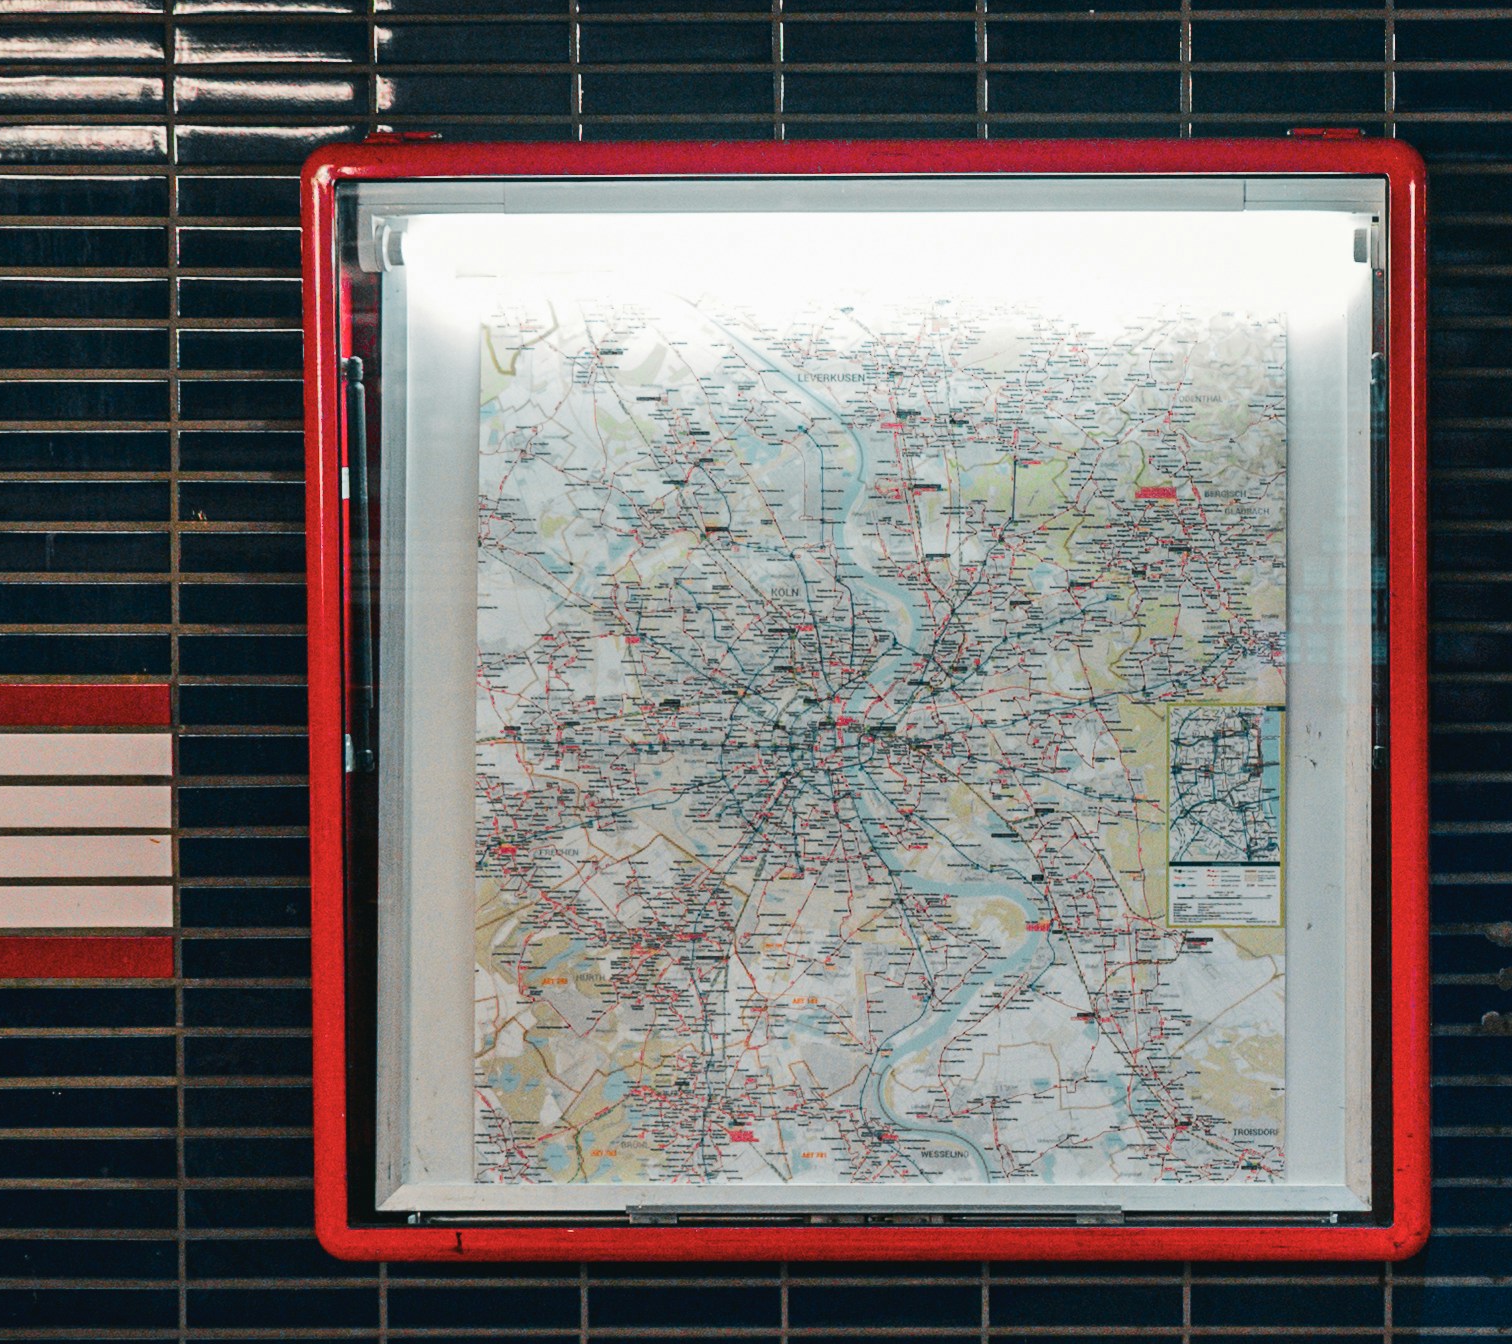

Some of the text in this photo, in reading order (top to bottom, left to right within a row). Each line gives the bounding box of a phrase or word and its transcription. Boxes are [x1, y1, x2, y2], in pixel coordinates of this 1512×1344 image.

[797, 373, 866, 383] LEVERKUSEN
[771, 587, 799, 597] KÖLN
[1233, 1128, 1280, 1136] TROISDORF
